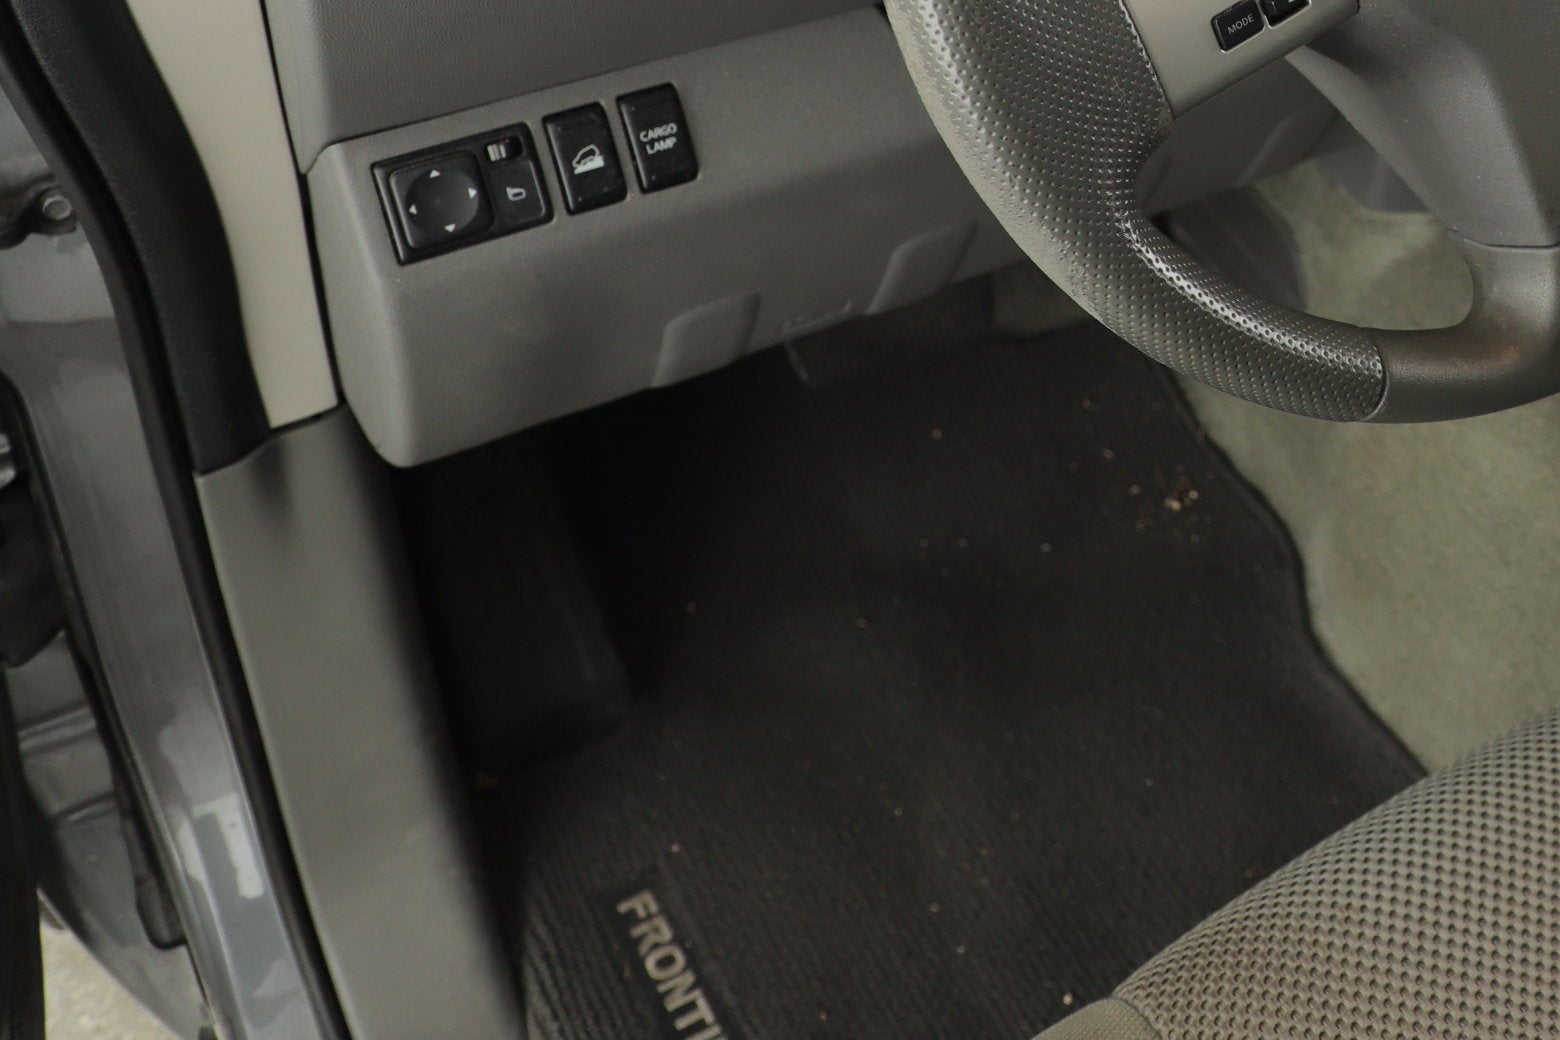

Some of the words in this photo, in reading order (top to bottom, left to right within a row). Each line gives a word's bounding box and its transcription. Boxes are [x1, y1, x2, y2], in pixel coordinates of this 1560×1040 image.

[1227, 13, 1255, 34] MODE
[639, 122, 678, 143] CARGO
[645, 136, 678, 155] LAMP
[616, 889, 728, 1040] FRONTI
